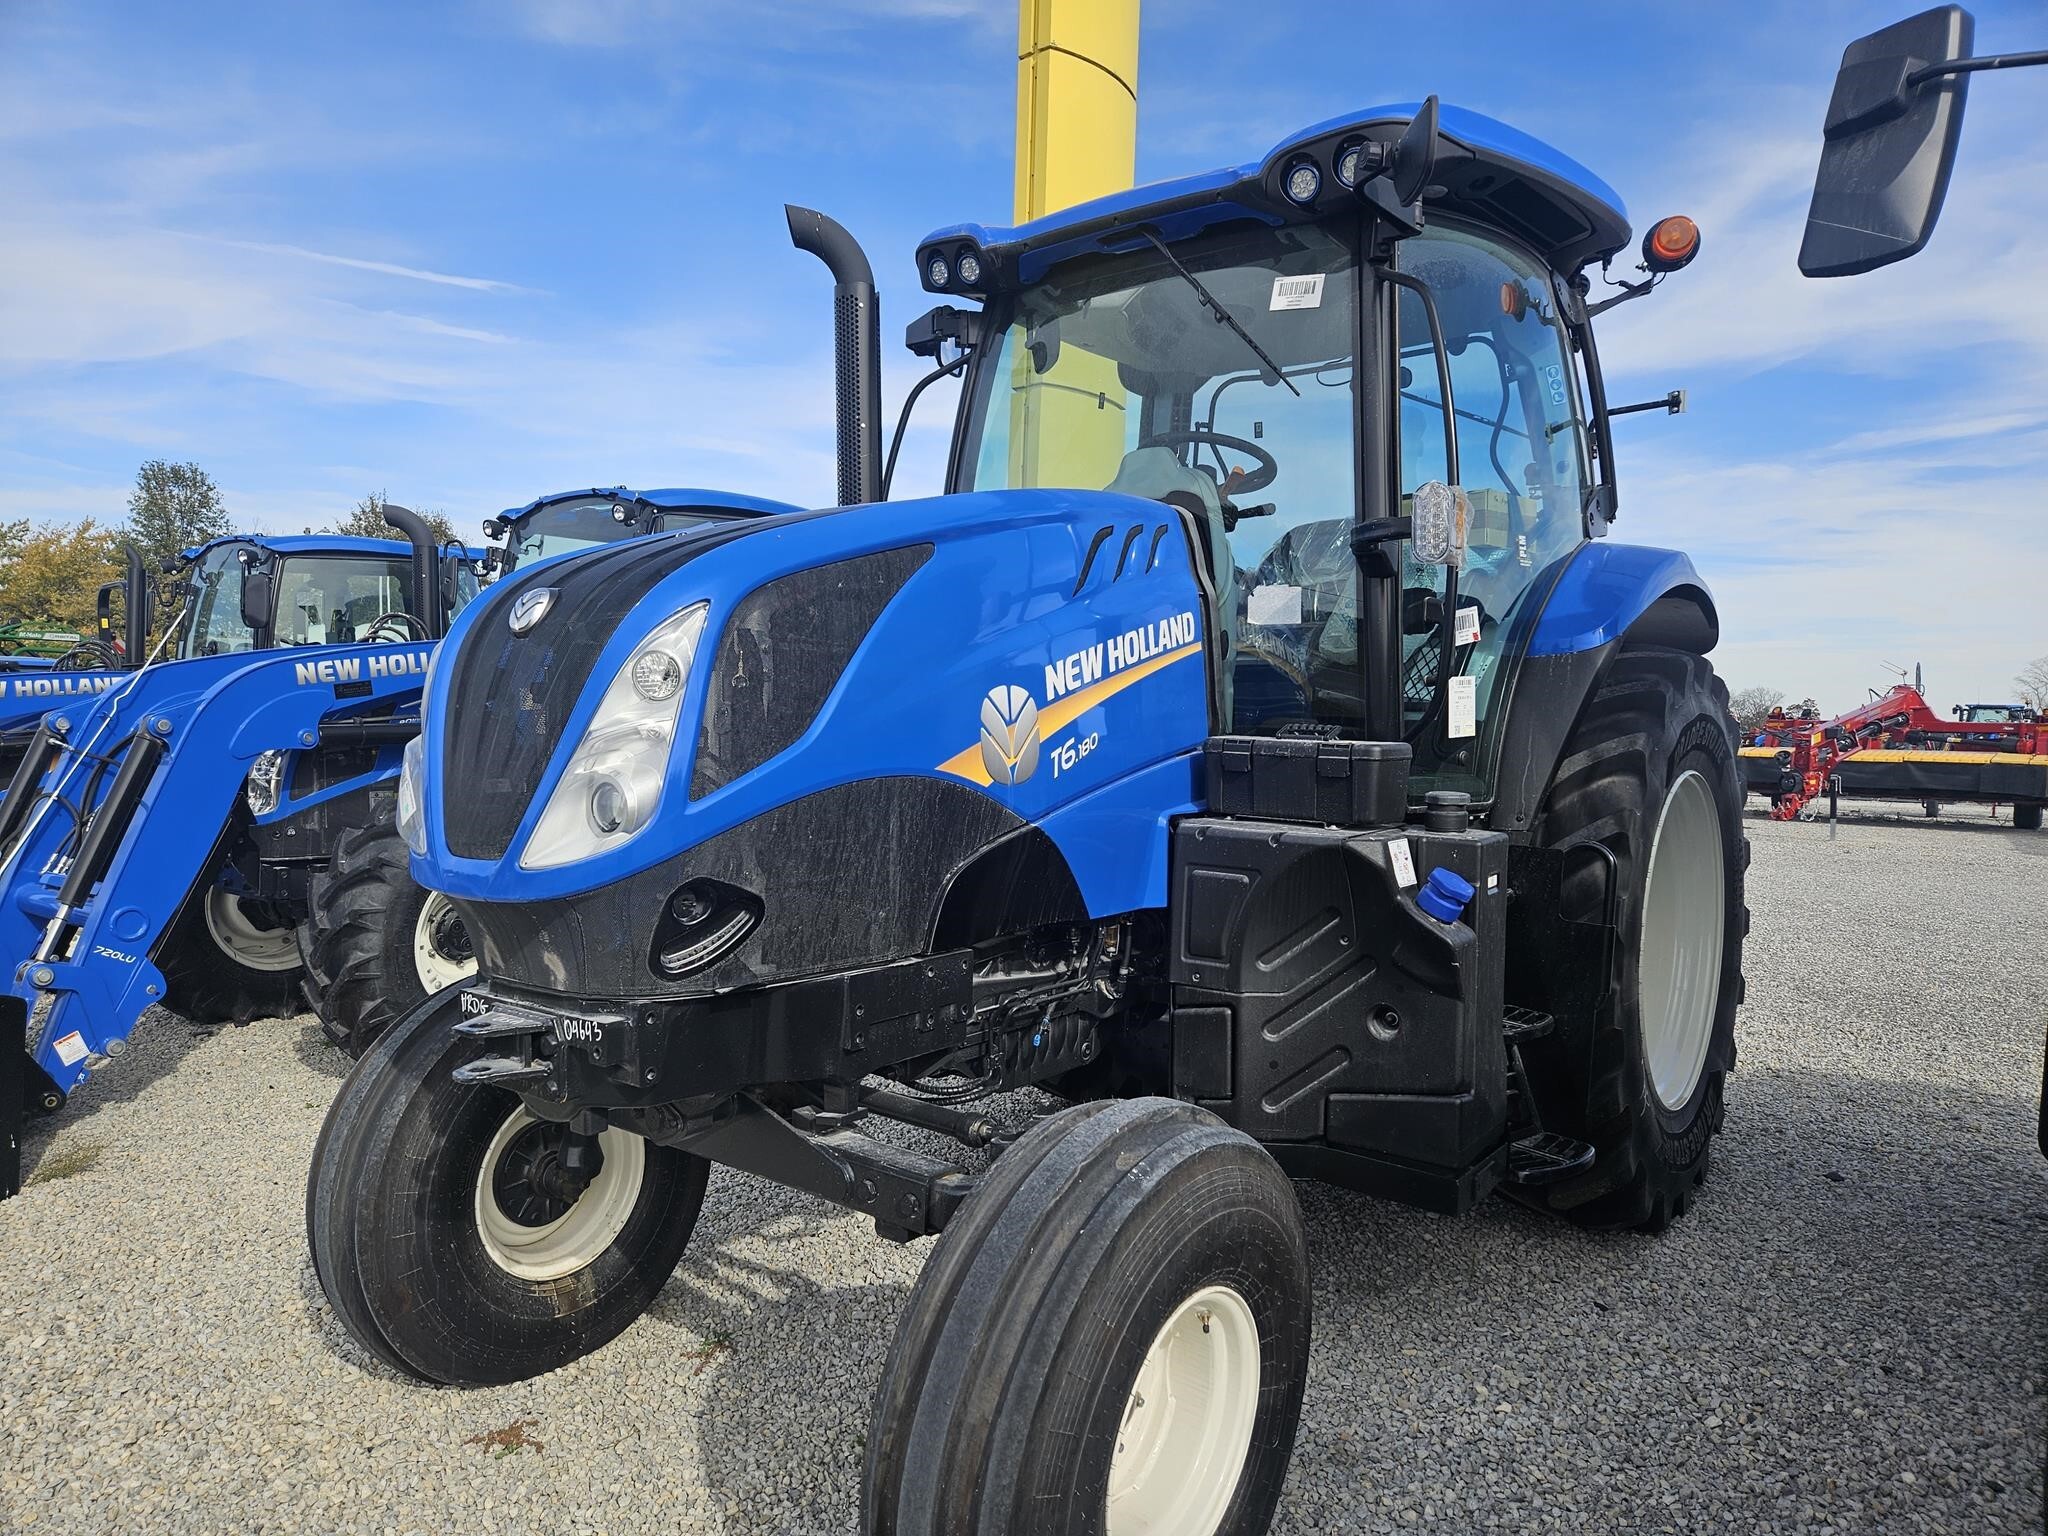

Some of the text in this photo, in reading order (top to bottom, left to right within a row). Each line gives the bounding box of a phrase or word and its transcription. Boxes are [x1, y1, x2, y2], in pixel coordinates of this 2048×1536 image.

[295, 652, 428, 685] NEW HOLL
[1045, 612, 1195, 701] NEW HOLLAND
[14, 677, 124, 697] HOLLAN
[1051, 732, 1098, 779] T6.180
[93, 945, 137, 963] 720LU
